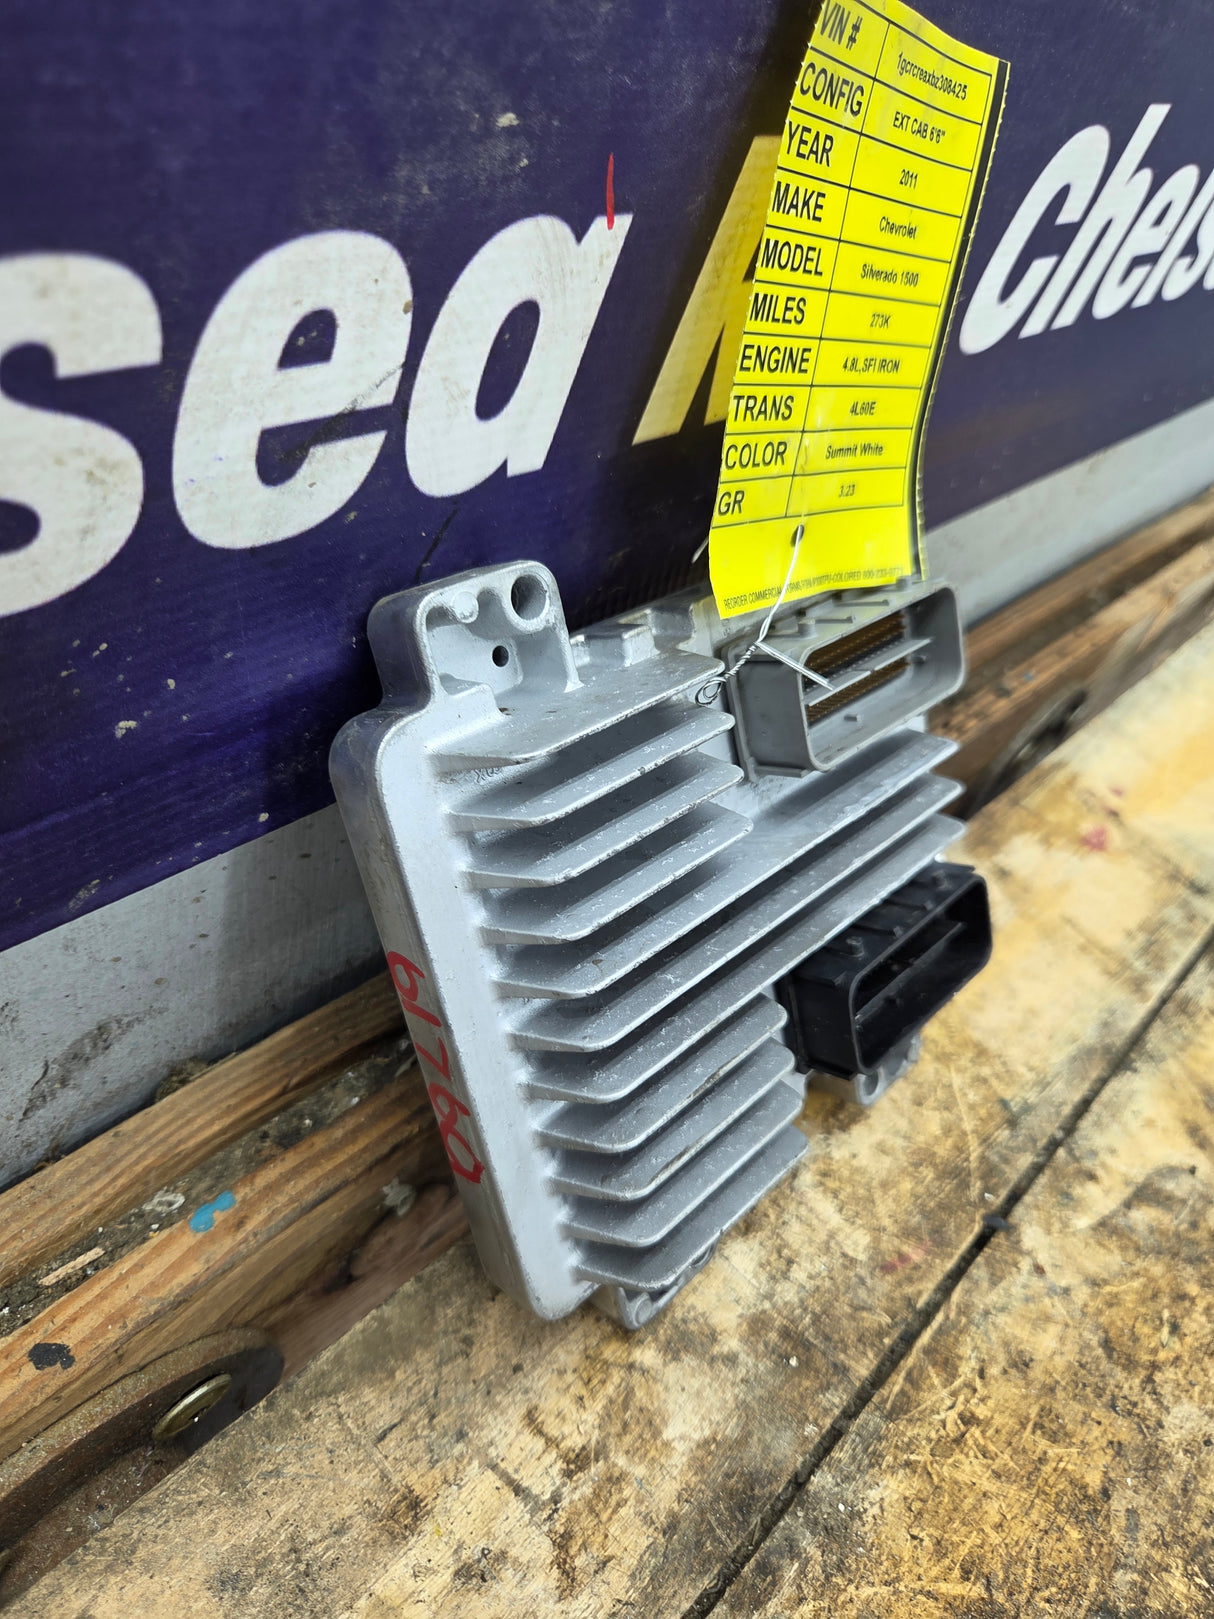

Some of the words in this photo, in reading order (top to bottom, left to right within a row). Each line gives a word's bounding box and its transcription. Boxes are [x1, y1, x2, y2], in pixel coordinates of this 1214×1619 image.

[819, 2, 852, 42] VIN
[845, 16, 863, 50] #
[799, 62, 865, 118] CONFIG
[893, 111, 911, 132] EXT
[911, 118, 929, 140] CAB
[785, 120, 834, 168] YEAR
[899, 168, 918, 189] 2011
[772, 180, 826, 223] MAKE
[879, 215, 917, 240] Chevrolet
[760, 238, 823, 277] MODEL
[860, 263, 898, 284] Silverado
[900, 270, 919, 287] 1500
[749, 292, 807, 325] MILES
[870, 312, 891, 329] 273K
[738, 344, 812, 375] ENGINE
[877, 358, 900, 374] IRON
[732, 394, 794, 422] TRANS
[850, 401, 877, 416] 4L60E
[724, 440, 787, 470] COLOR
[825, 444, 857, 460] Summit
[859, 442, 884, 457] White
[717, 490, 745, 517] GR
[723, 594, 748, 610] REORDER
[385, 950, 486, 1184] 61760
